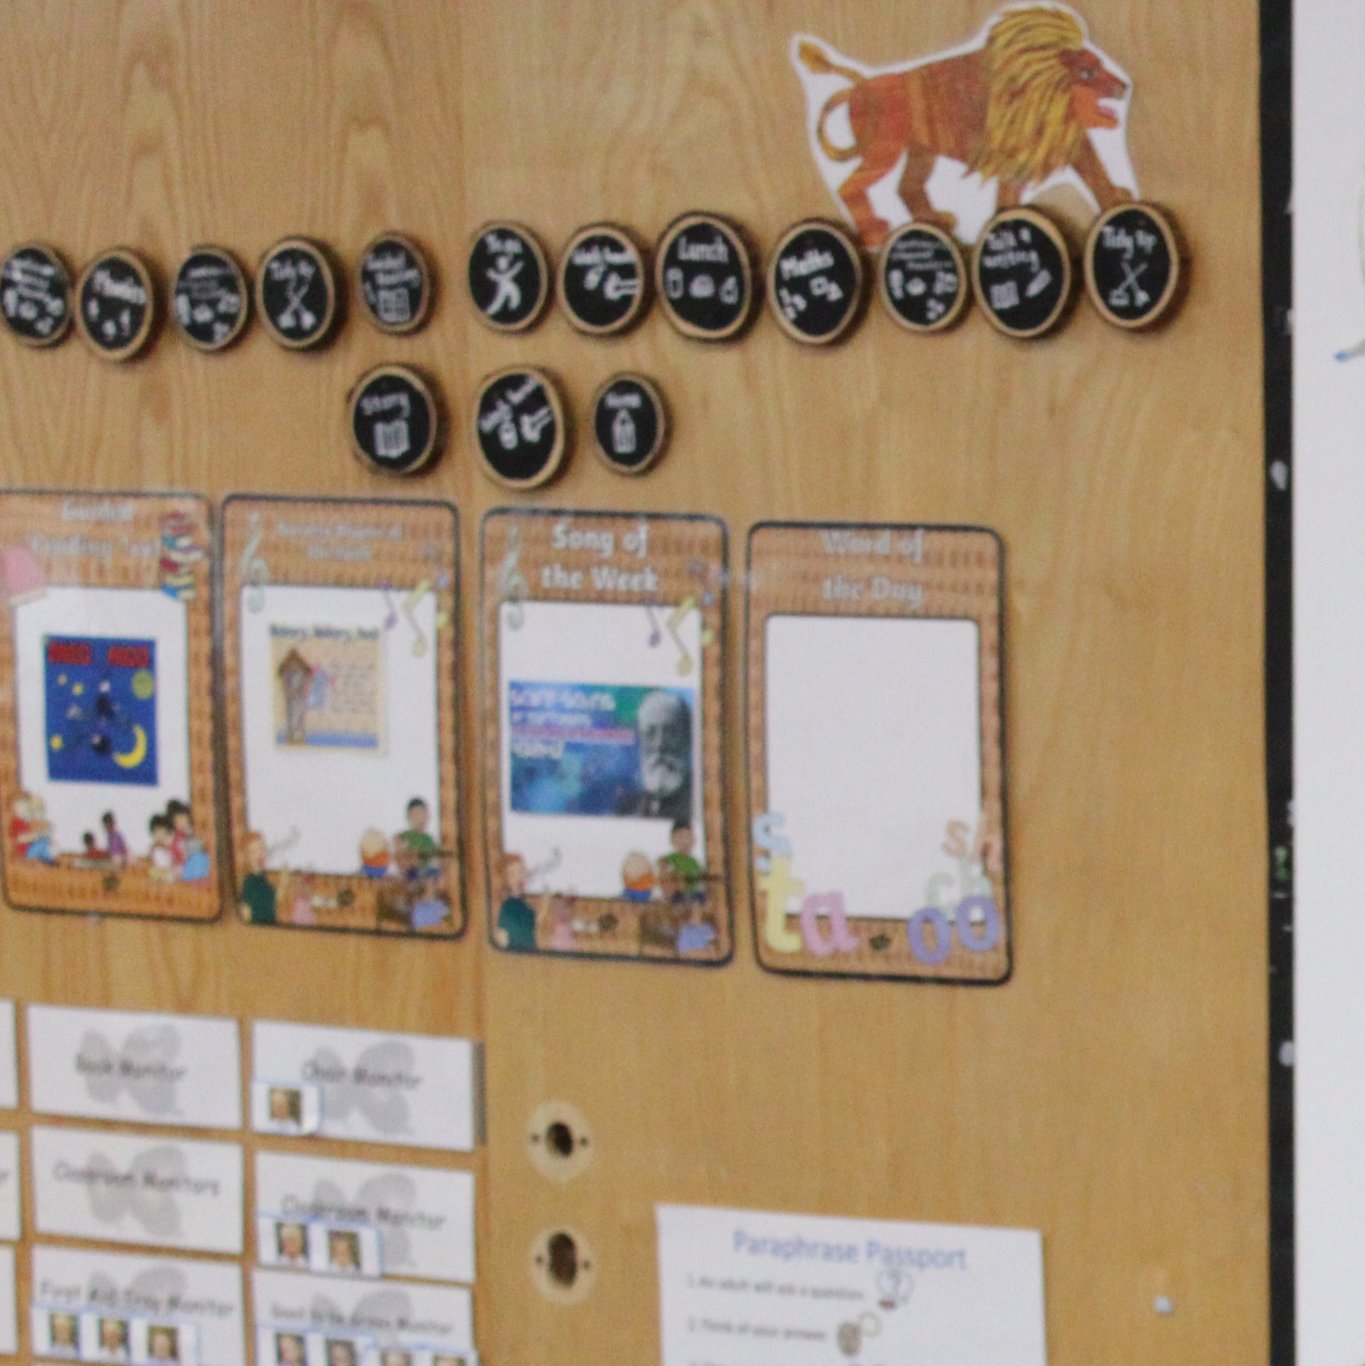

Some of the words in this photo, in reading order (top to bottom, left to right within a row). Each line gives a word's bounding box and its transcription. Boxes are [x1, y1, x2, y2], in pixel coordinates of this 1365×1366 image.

[553, 522, 615, 558] Song
[624, 523, 649, 560] of
[821, 530, 890, 556] Word
[898, 530, 924, 563] of
[541, 566, 582, 591] the
[591, 567, 659, 594] Week
[822, 577, 860, 602] the
[872, 576, 924, 609] Day
[733, 1229, 859, 1265] Paraphrase
[866, 1239, 967, 1272] Passport
